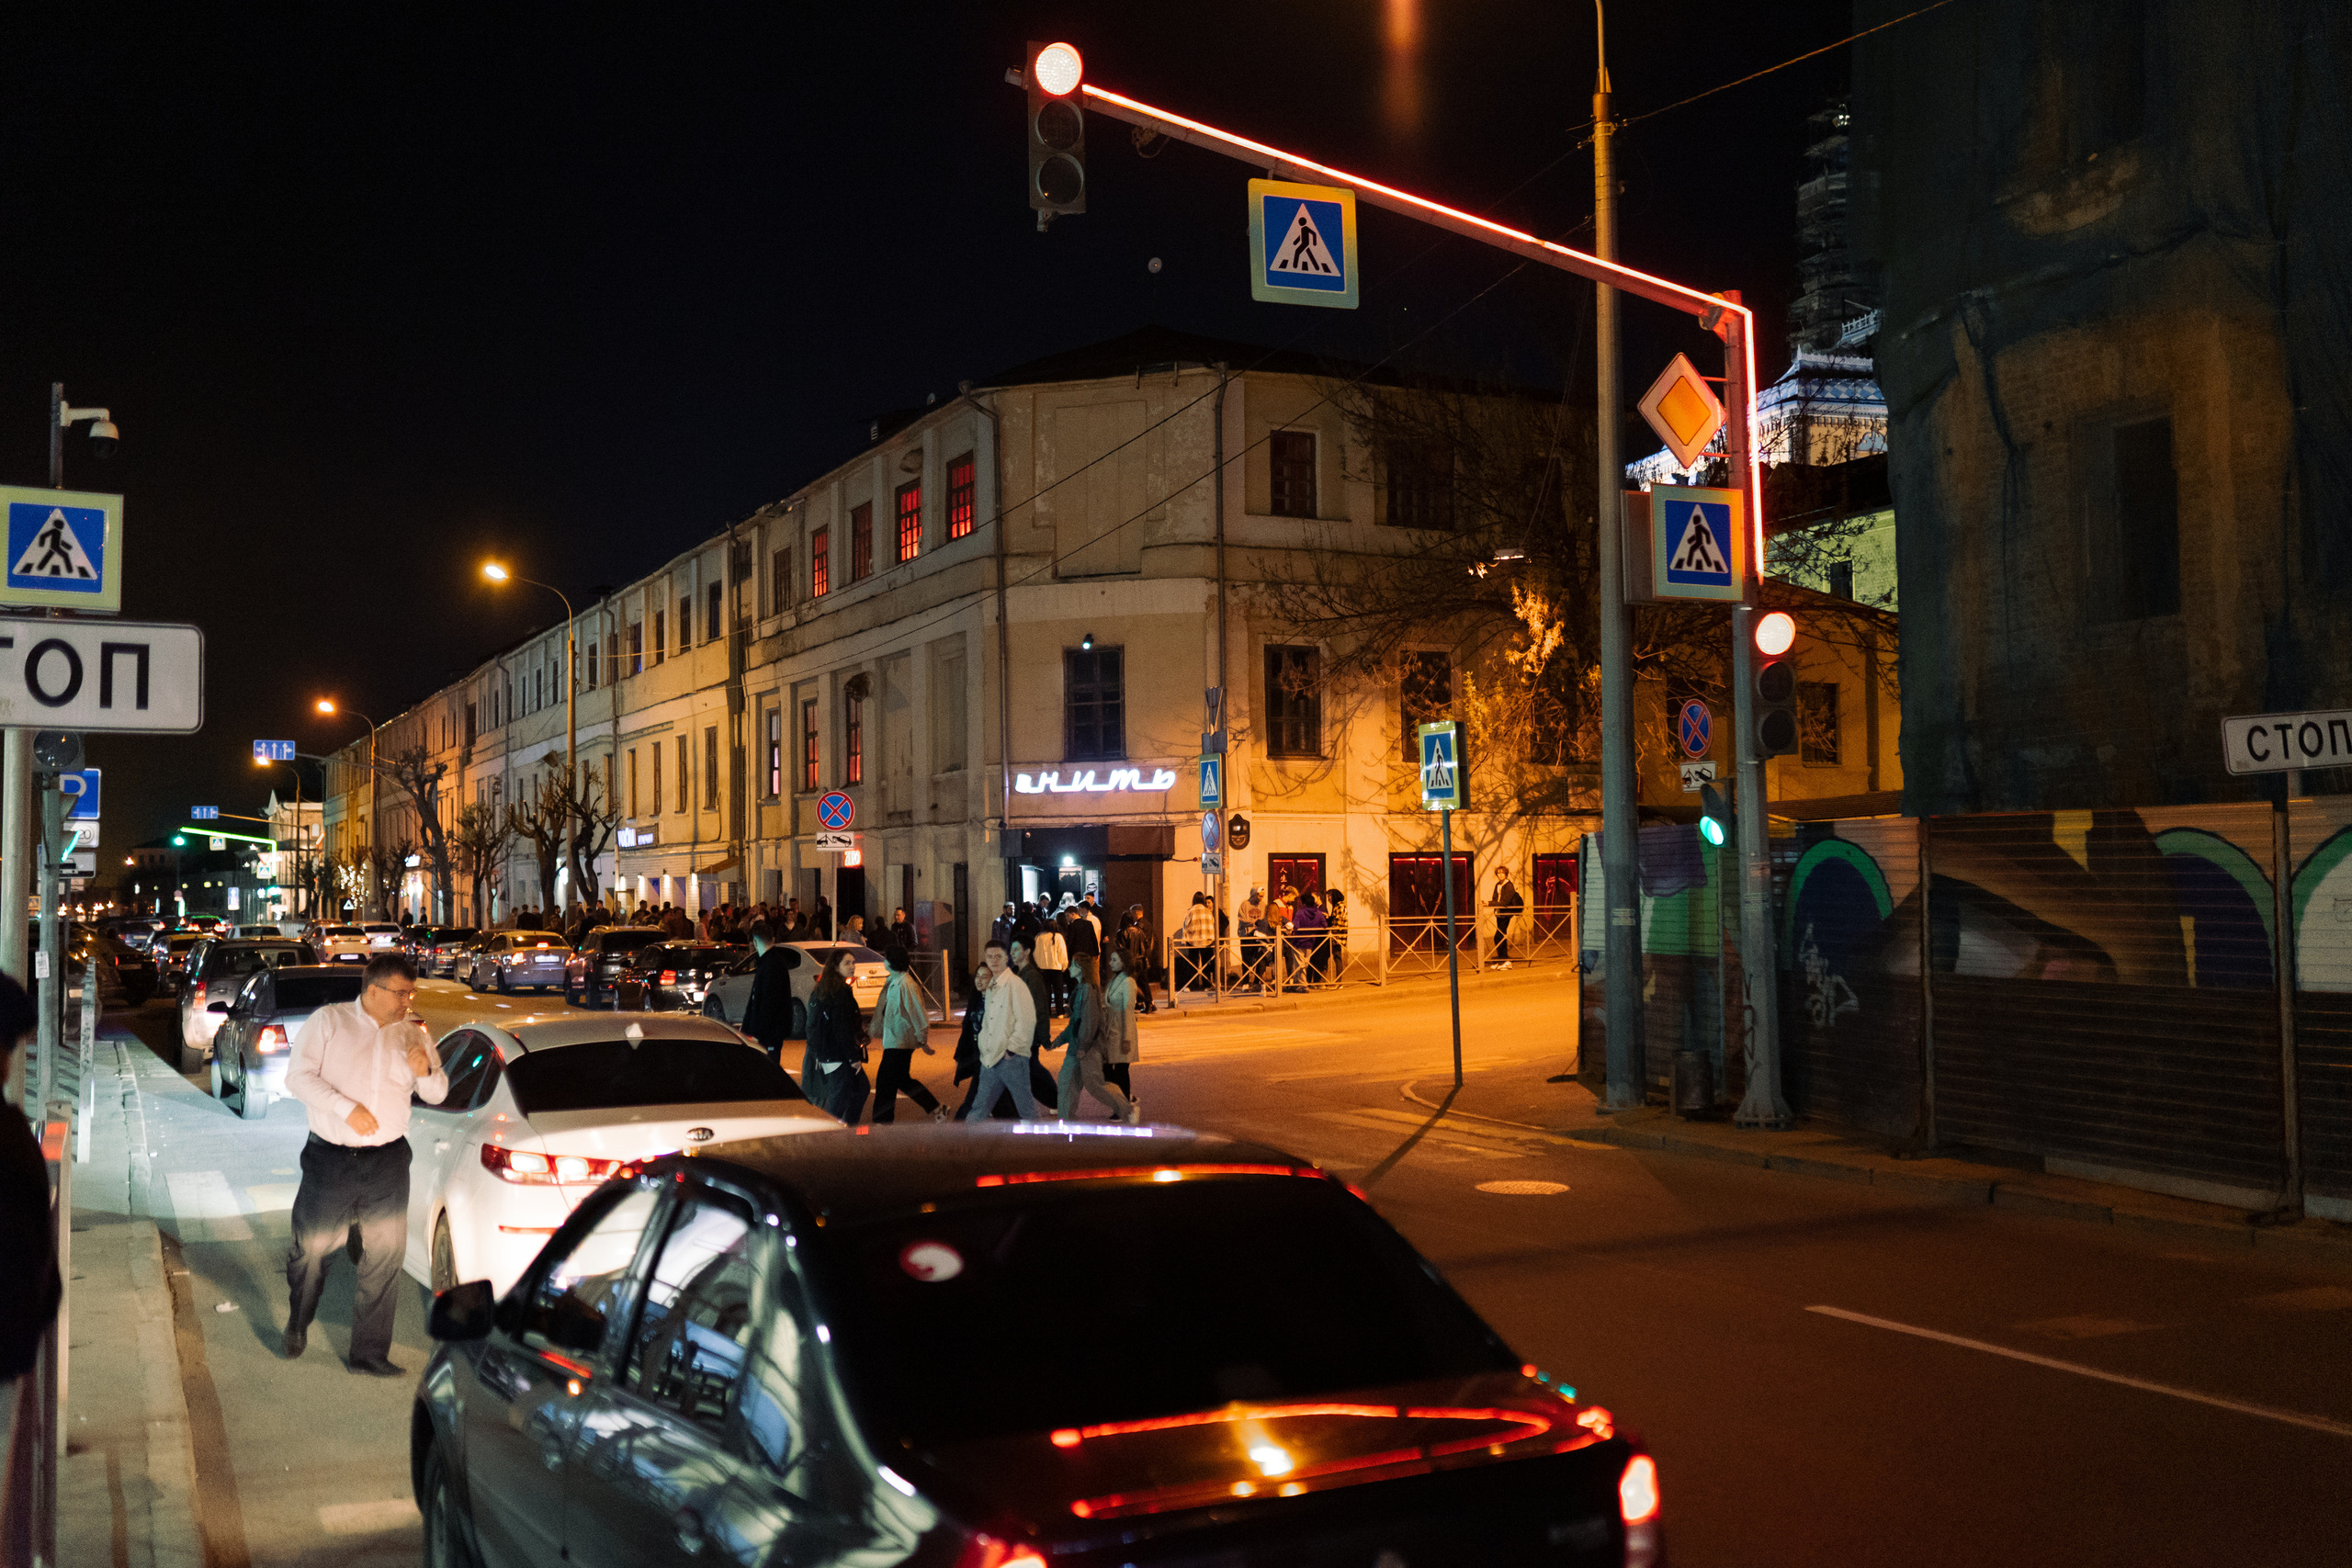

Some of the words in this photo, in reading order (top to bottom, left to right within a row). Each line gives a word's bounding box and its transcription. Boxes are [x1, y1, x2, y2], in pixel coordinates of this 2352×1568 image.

[0, 636, 150, 710] ОП
[2246, 719, 2352, 762] СТОП
[686, 1128, 712, 1140] KIA
